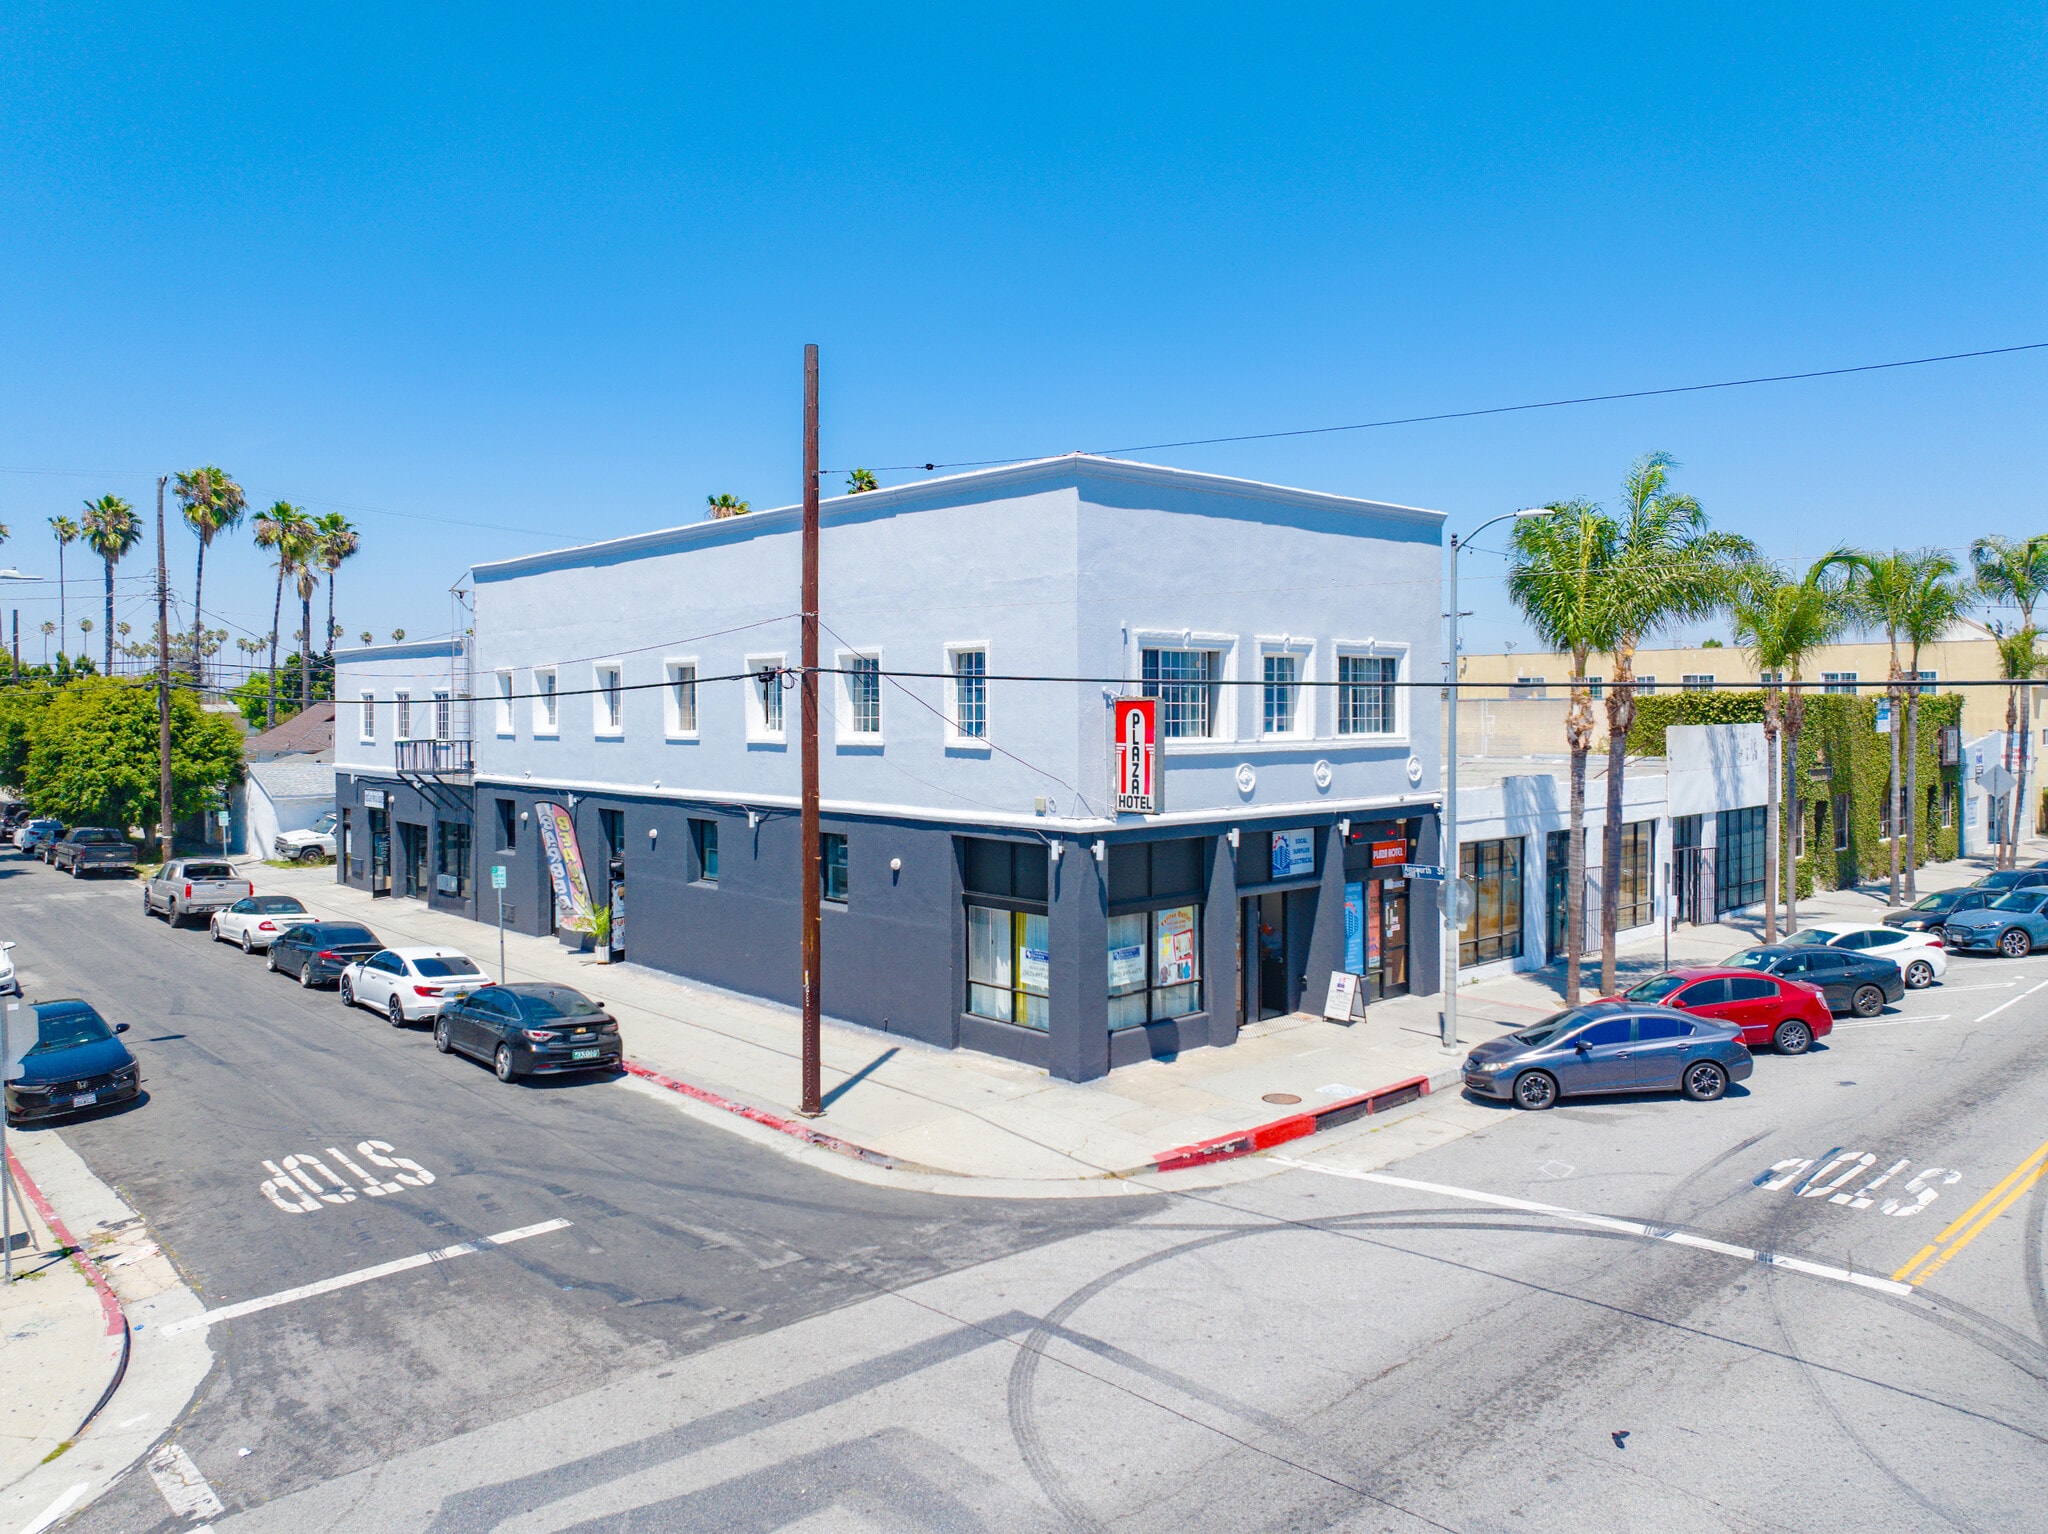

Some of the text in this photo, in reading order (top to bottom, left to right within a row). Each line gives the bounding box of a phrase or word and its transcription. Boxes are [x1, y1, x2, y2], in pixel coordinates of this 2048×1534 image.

[1132, 713, 1140, 794] PLAZA
[1119, 795, 1152, 809] HOTEL
[540, 814, 574, 911] BARBER
[556, 815, 592, 917] BEAUTY
[260, 1140, 436, 1213] STOP
[1752, 1147, 1962, 1217] STOP
